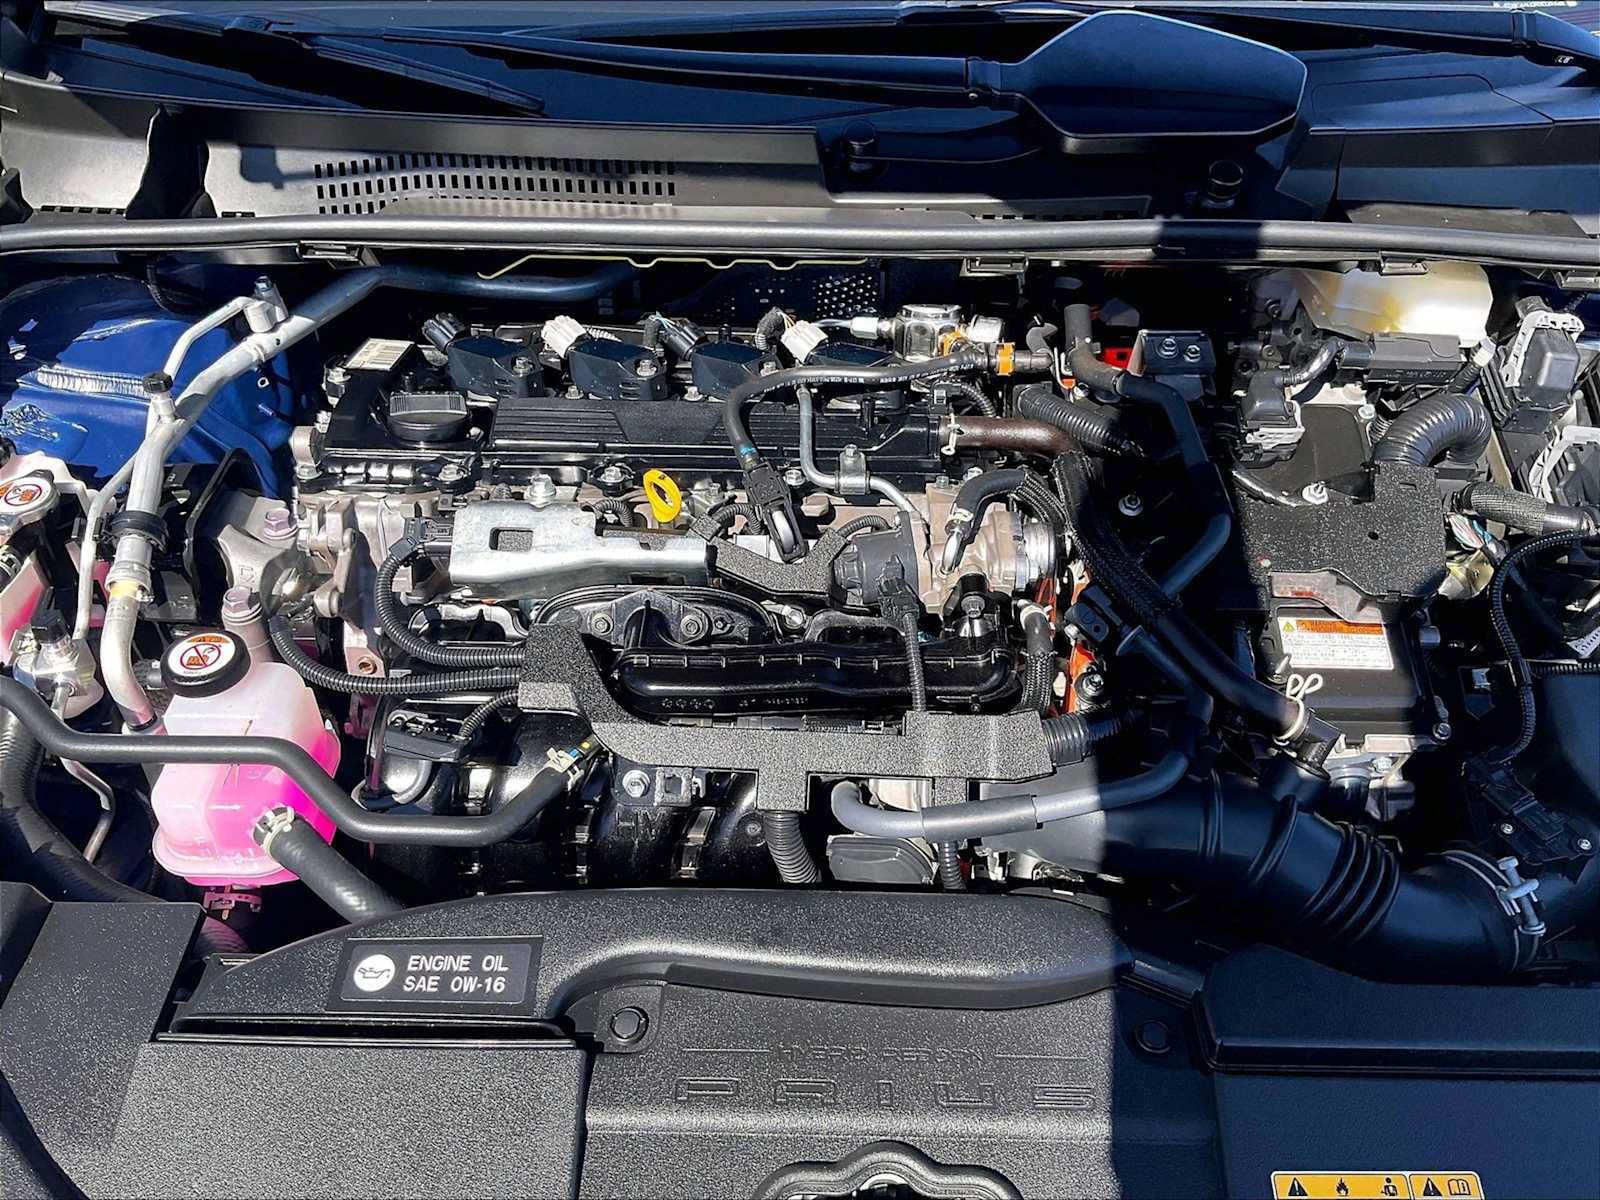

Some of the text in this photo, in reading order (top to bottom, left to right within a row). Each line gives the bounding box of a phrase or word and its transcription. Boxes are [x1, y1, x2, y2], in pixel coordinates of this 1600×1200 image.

[407, 955, 509, 971] ENGINE OIL
[403, 976, 440, 992] SAE
[674, 1076, 1099, 1111] PRIUS
